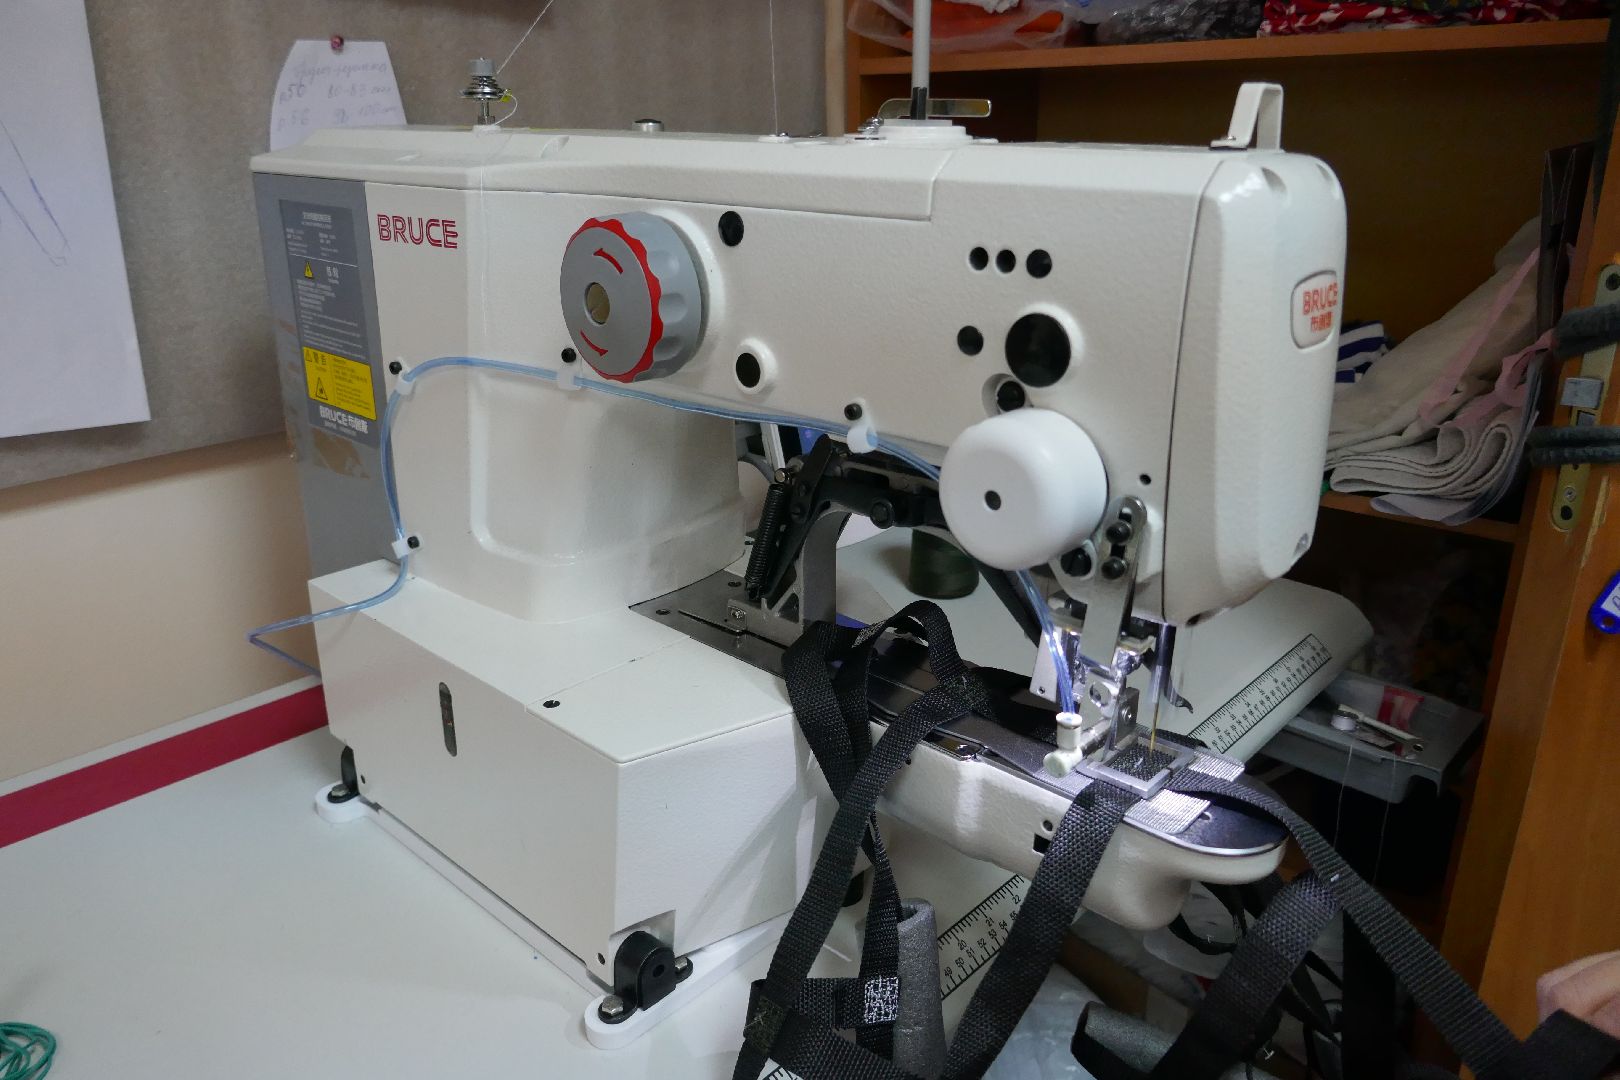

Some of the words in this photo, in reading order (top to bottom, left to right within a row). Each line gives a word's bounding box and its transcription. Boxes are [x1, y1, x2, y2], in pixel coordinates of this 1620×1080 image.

[377, 213, 459, 249] BRUCE
[943, 966, 953, 977] 49
[954, 957, 965, 967] 50
[965, 947, 975, 958] 51
[977, 938, 987, 948] 52
[988, 929, 997, 939] 53
[998, 920, 1008, 930] 54
[958, 940, 967, 951] 20
[985, 917, 995, 927] 21
[1012, 894, 1021, 905] 22
